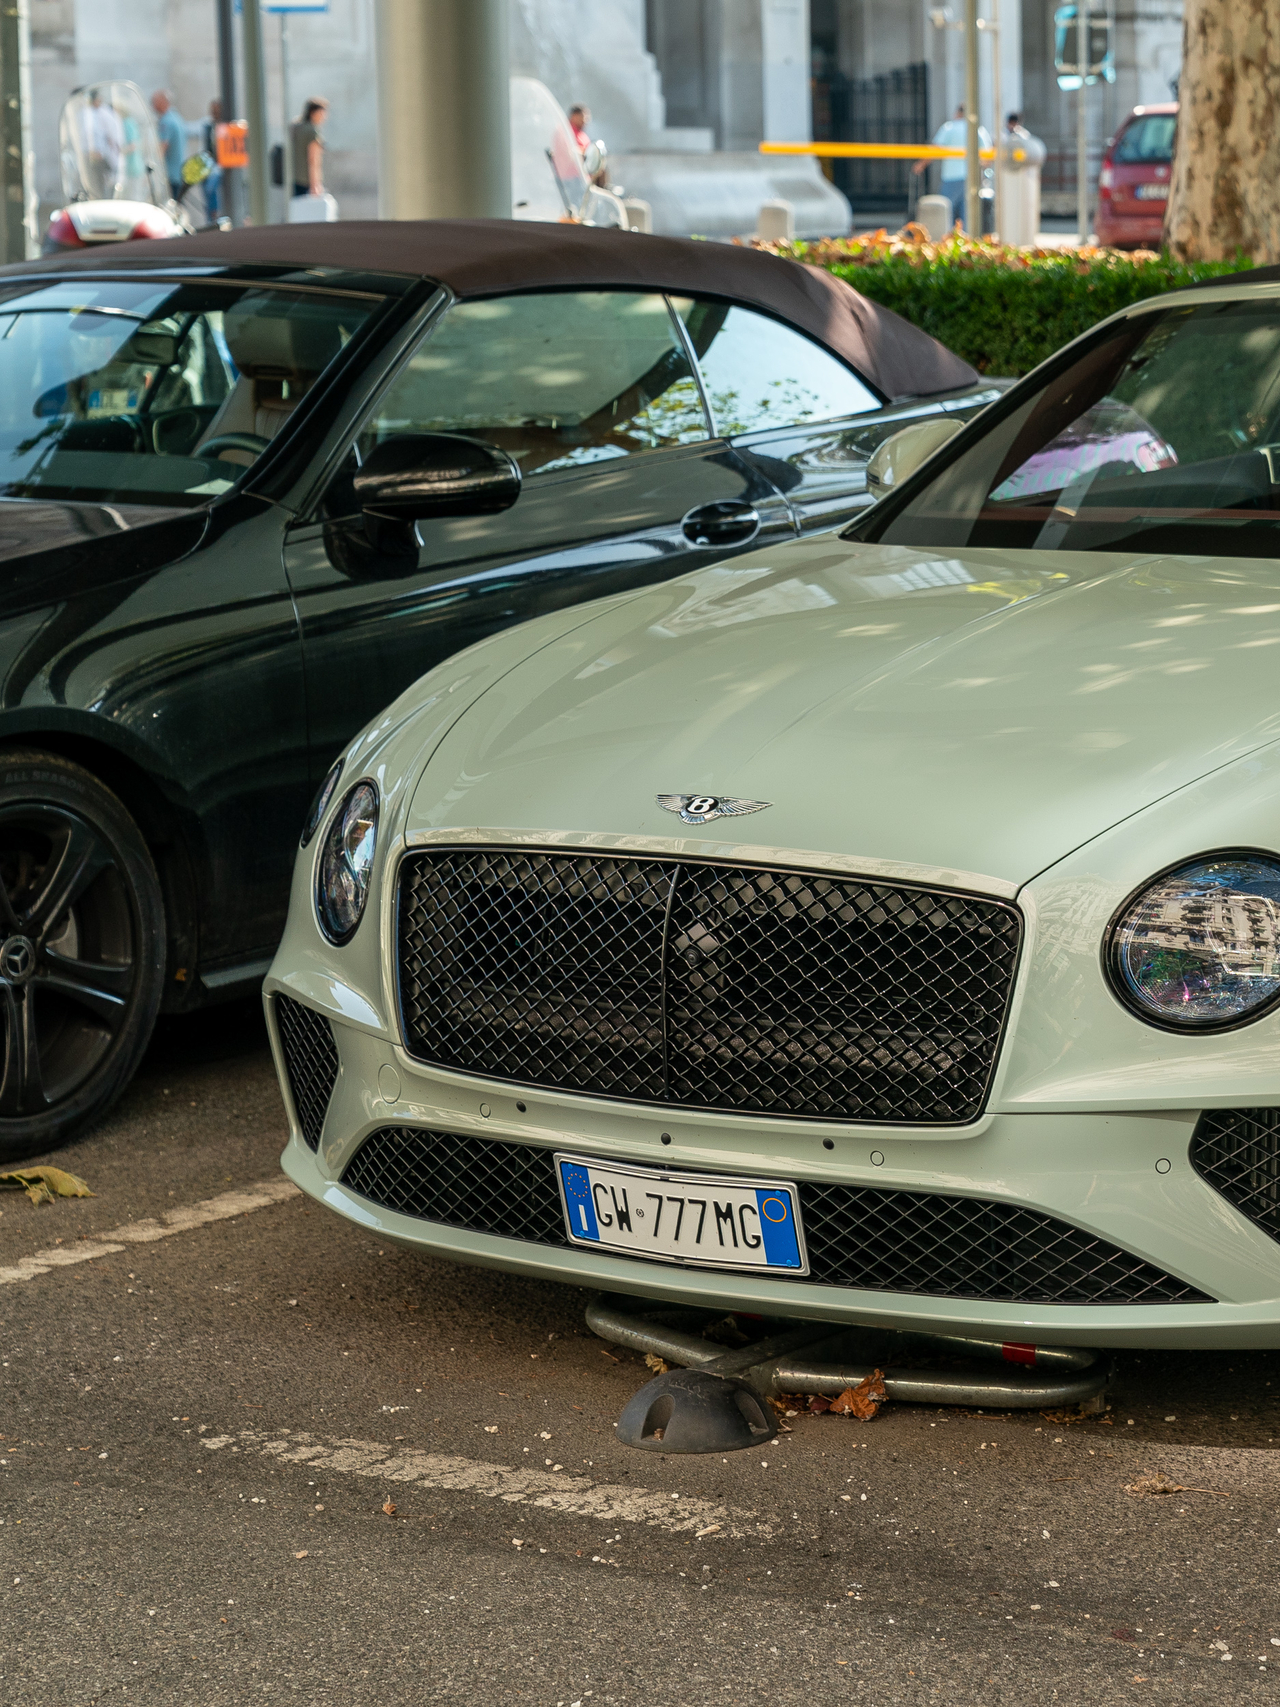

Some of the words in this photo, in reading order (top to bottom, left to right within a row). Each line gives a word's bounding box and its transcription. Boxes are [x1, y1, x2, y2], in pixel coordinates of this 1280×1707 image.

[687, 797, 715, 814] B
[578, 1204, 589, 1232] I
[591, 1181, 633, 1233] GW
[645, 1192, 762, 1249] 777MG
